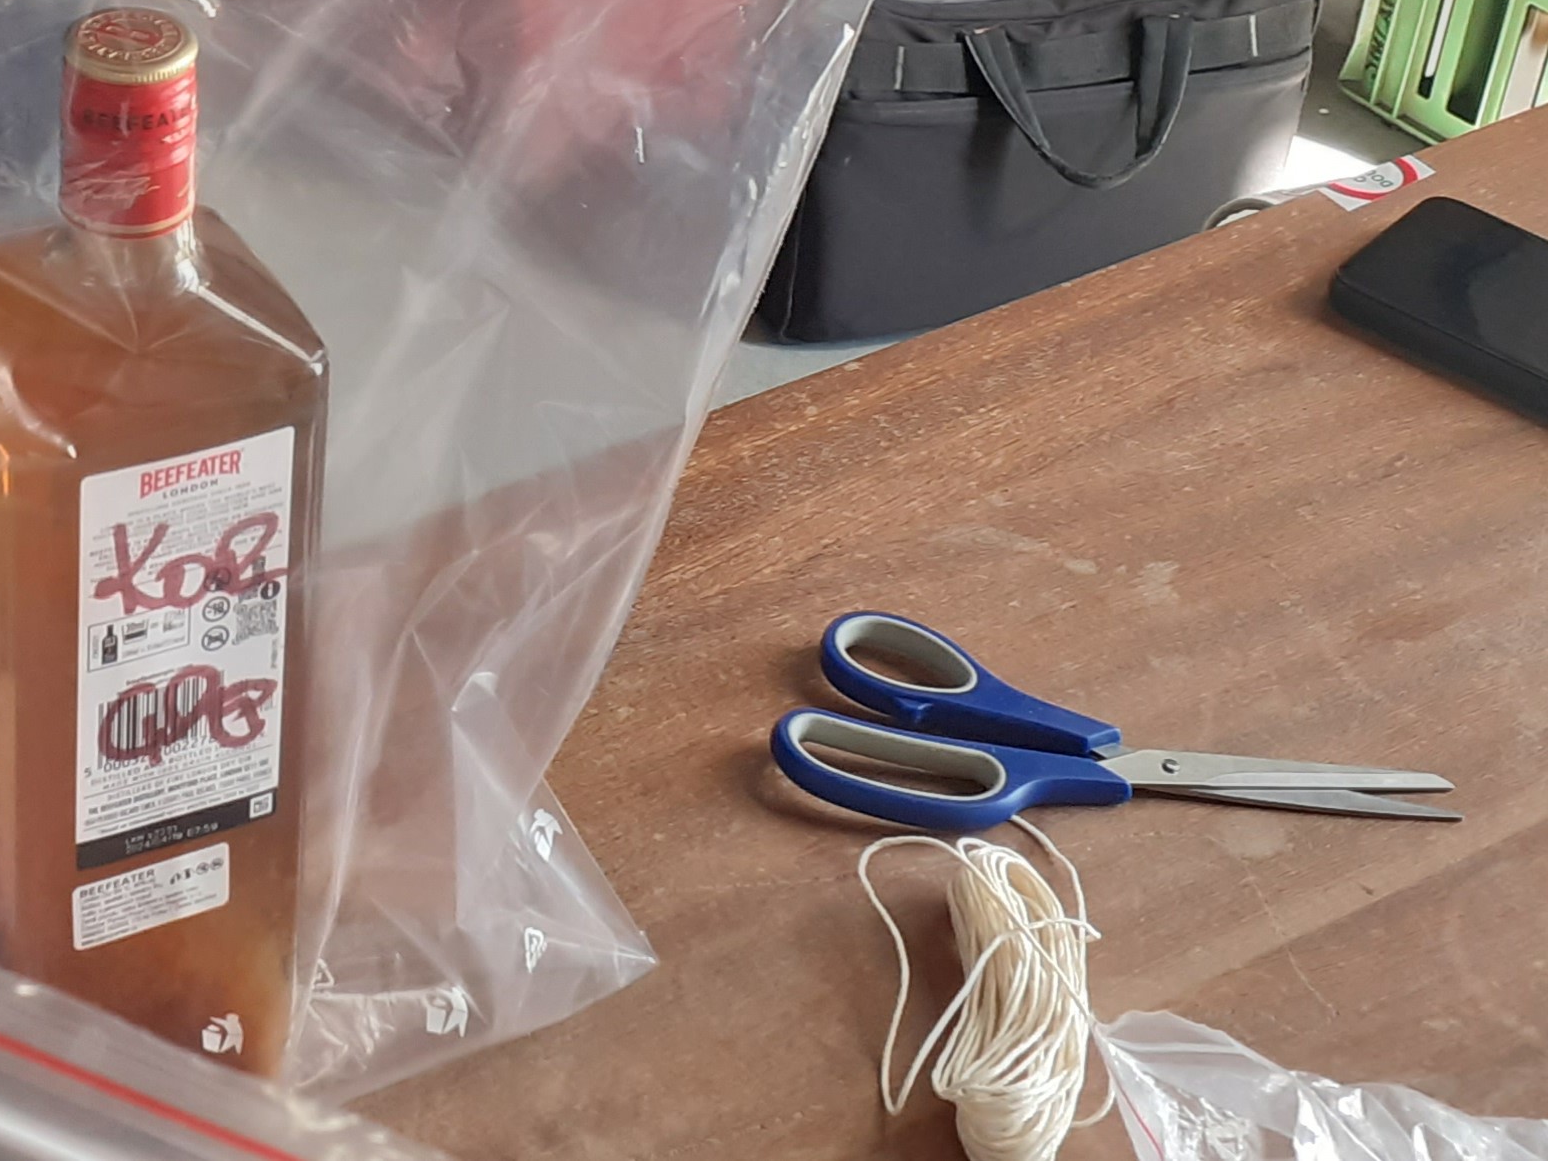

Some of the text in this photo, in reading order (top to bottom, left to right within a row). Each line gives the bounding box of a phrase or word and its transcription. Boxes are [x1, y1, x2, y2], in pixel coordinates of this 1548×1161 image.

[139, 449, 242, 498] BEEFEATER
[162, 478, 219, 500] LONDON
[84, 768, 92, 778] 5
[79, 868, 155, 897] BEEFEATER
